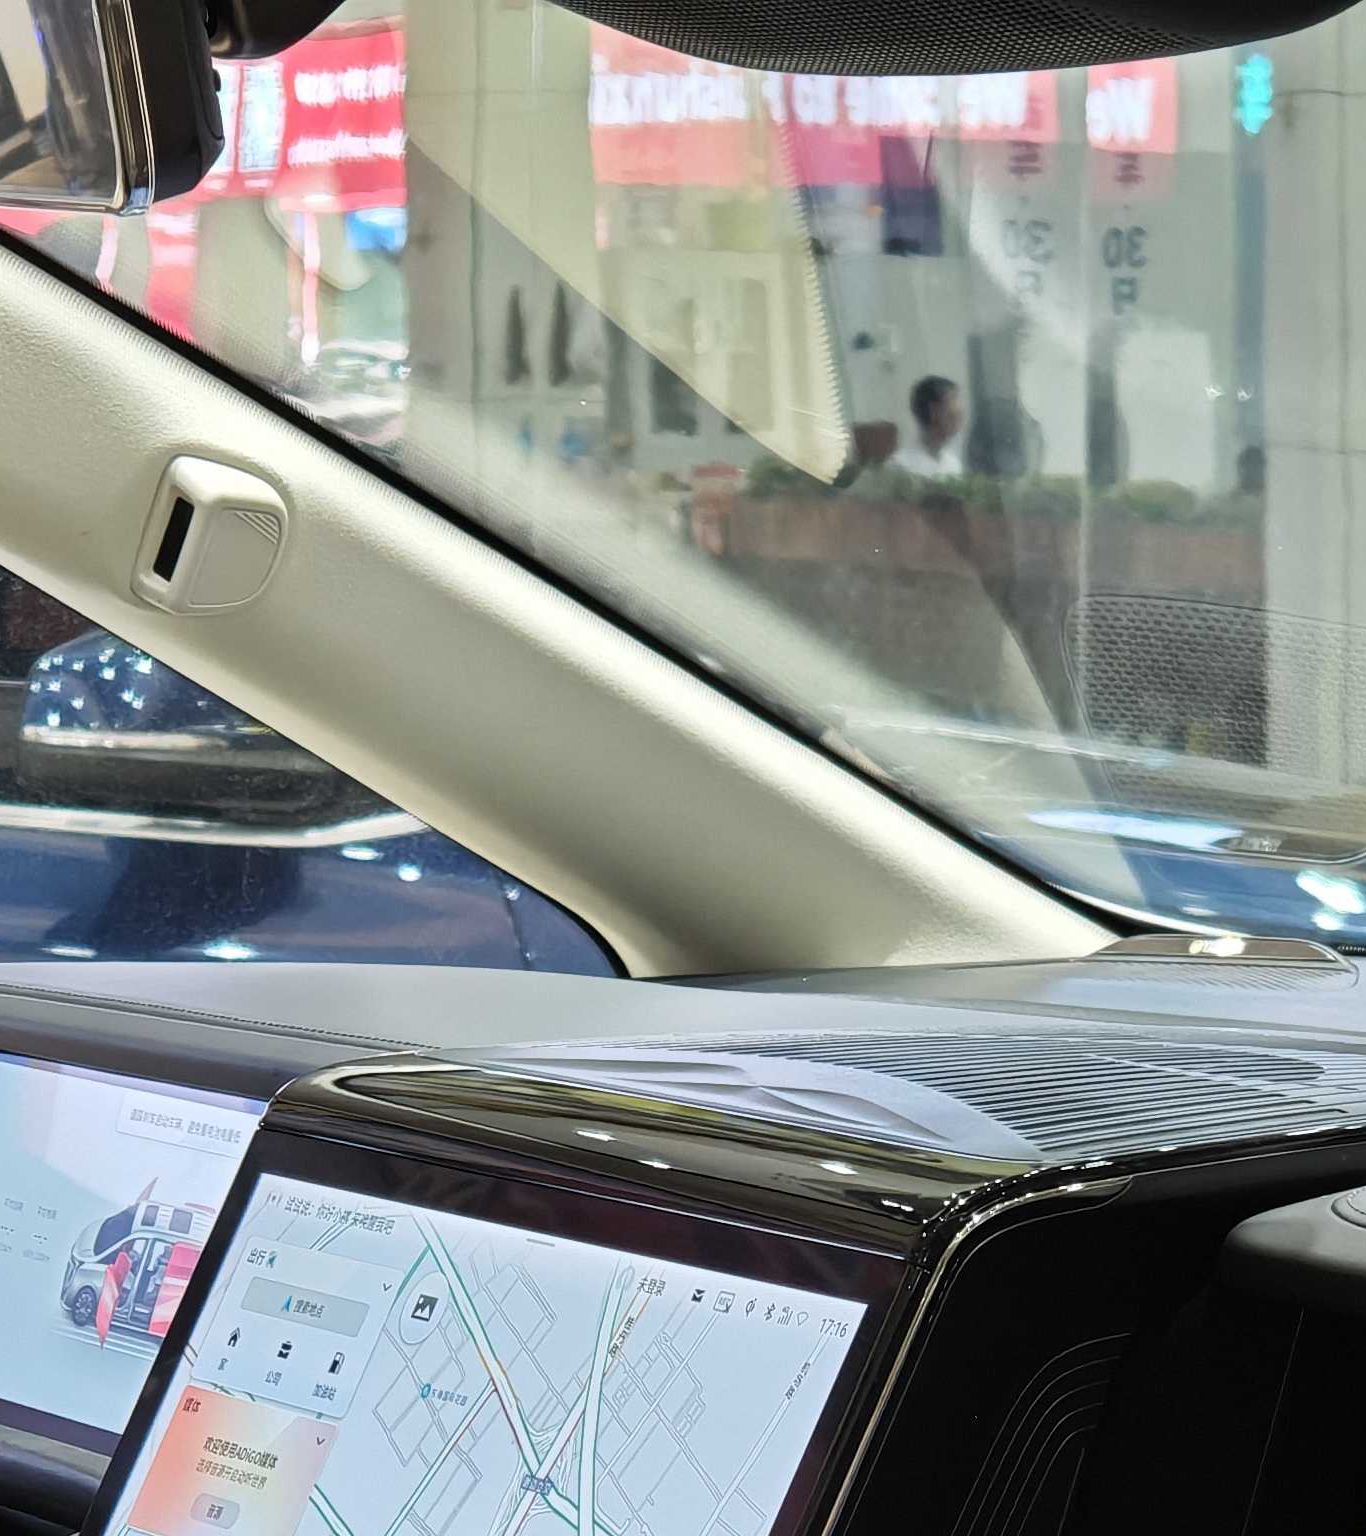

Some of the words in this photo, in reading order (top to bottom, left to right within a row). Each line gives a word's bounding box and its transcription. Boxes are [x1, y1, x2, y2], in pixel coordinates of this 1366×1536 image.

[246, 1247, 268, 1267] 出行
[636, 1276, 667, 1297] 未登录
[819, 1317, 848, 1339] 17:16
[182, 1396, 202, 1413] 媒体
[202, 1436, 279, 1471] 欢迎使用ADiGO媒体
